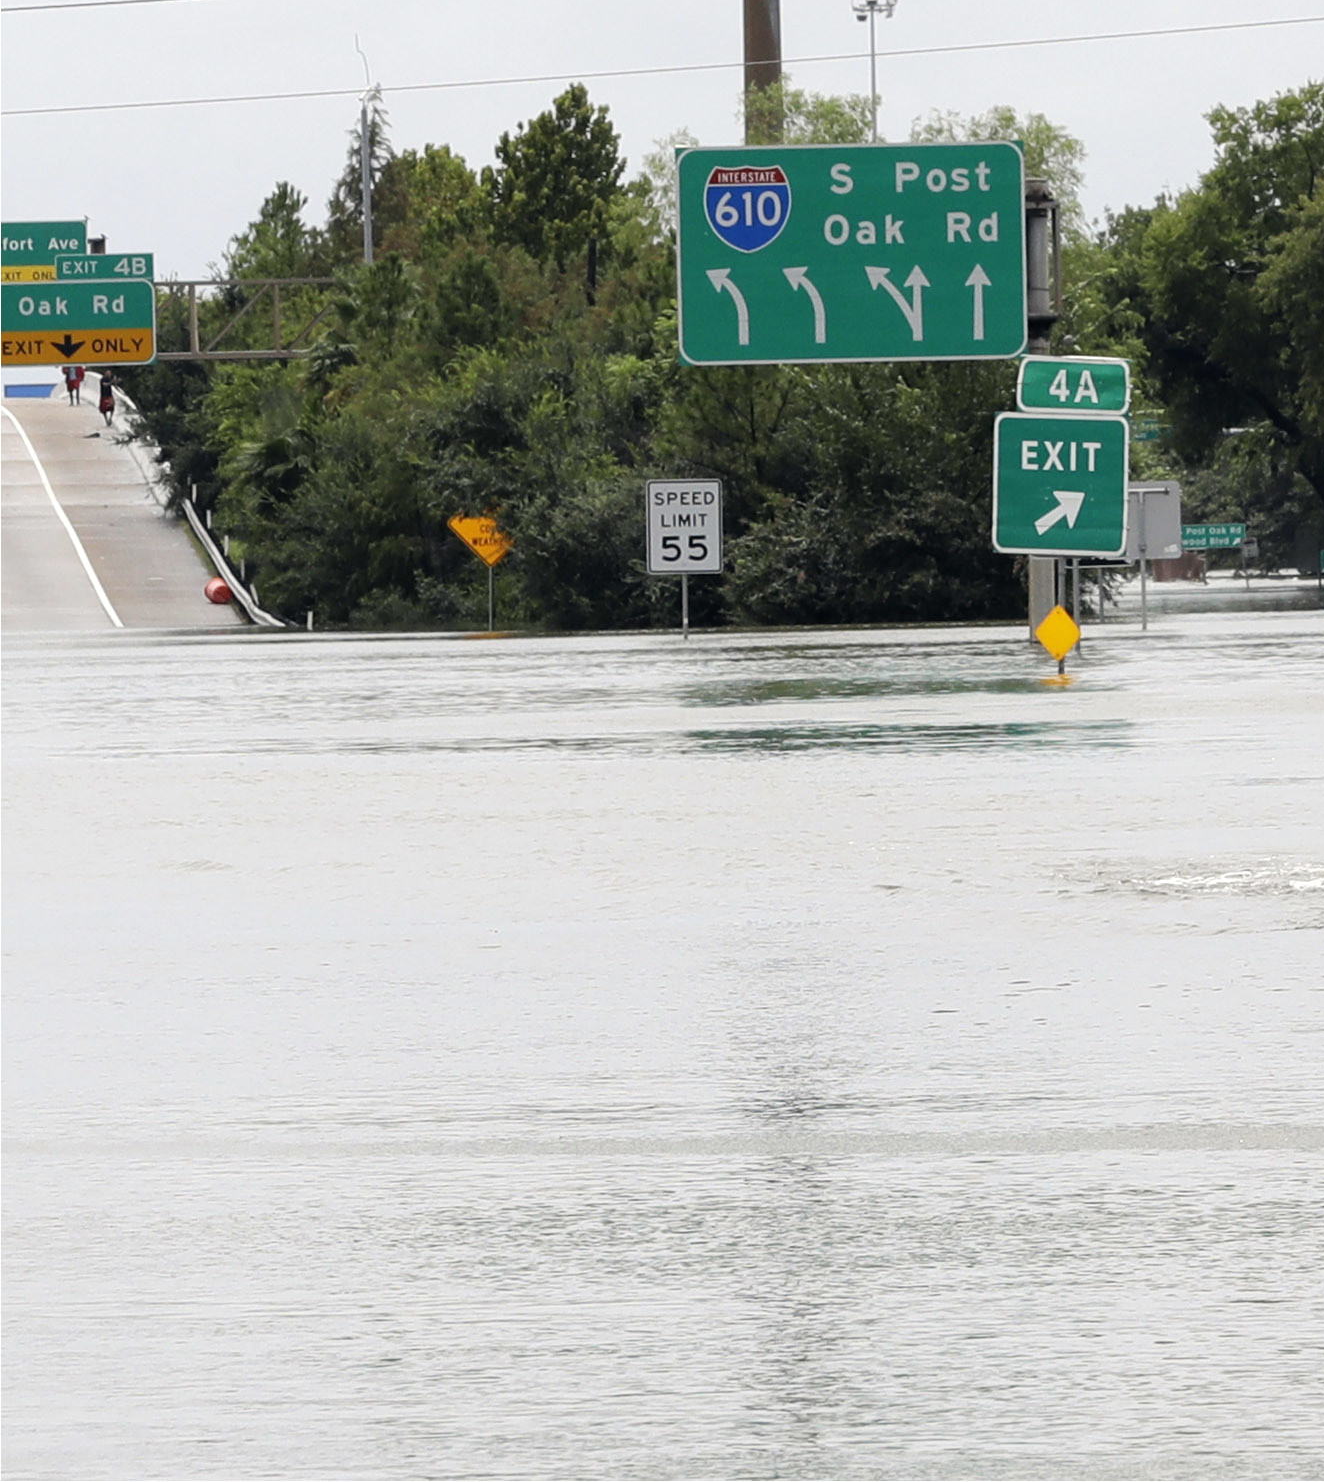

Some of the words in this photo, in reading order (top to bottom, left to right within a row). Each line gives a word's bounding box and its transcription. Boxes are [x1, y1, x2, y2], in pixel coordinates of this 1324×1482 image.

[717, 171, 777, 183] INTERSTATE
[830, 163, 854, 194] S
[894, 160, 992, 193] Post
[715, 190, 782, 228] 610
[824, 213, 905, 246] Oak
[946, 211, 1000, 243] Rd
[47, 237, 79, 250] Ave
[1, 271, 21, 281] XIT
[32, 270, 56, 281] ONL
[62, 261, 98, 275] EXIT
[113, 257, 147, 276] 4B
[18, 296, 69, 316] Oak
[92, 294, 125, 315] Rd
[2, 340, 44, 356] EXIT
[91, 338, 144, 354] ONLY
[1048, 369, 1099, 404] 4A
[1021, 440, 1102, 472] EXIT
[654, 491, 715, 507] SPEED
[661, 513, 708, 528] LIMIT
[1185, 527, 1206, 535] Post
[1208, 526, 1227, 535] Oak
[1230, 526, 1242, 534] Rd
[661, 534, 709, 562] 55
[1209, 537, 1230, 545] Blvd
